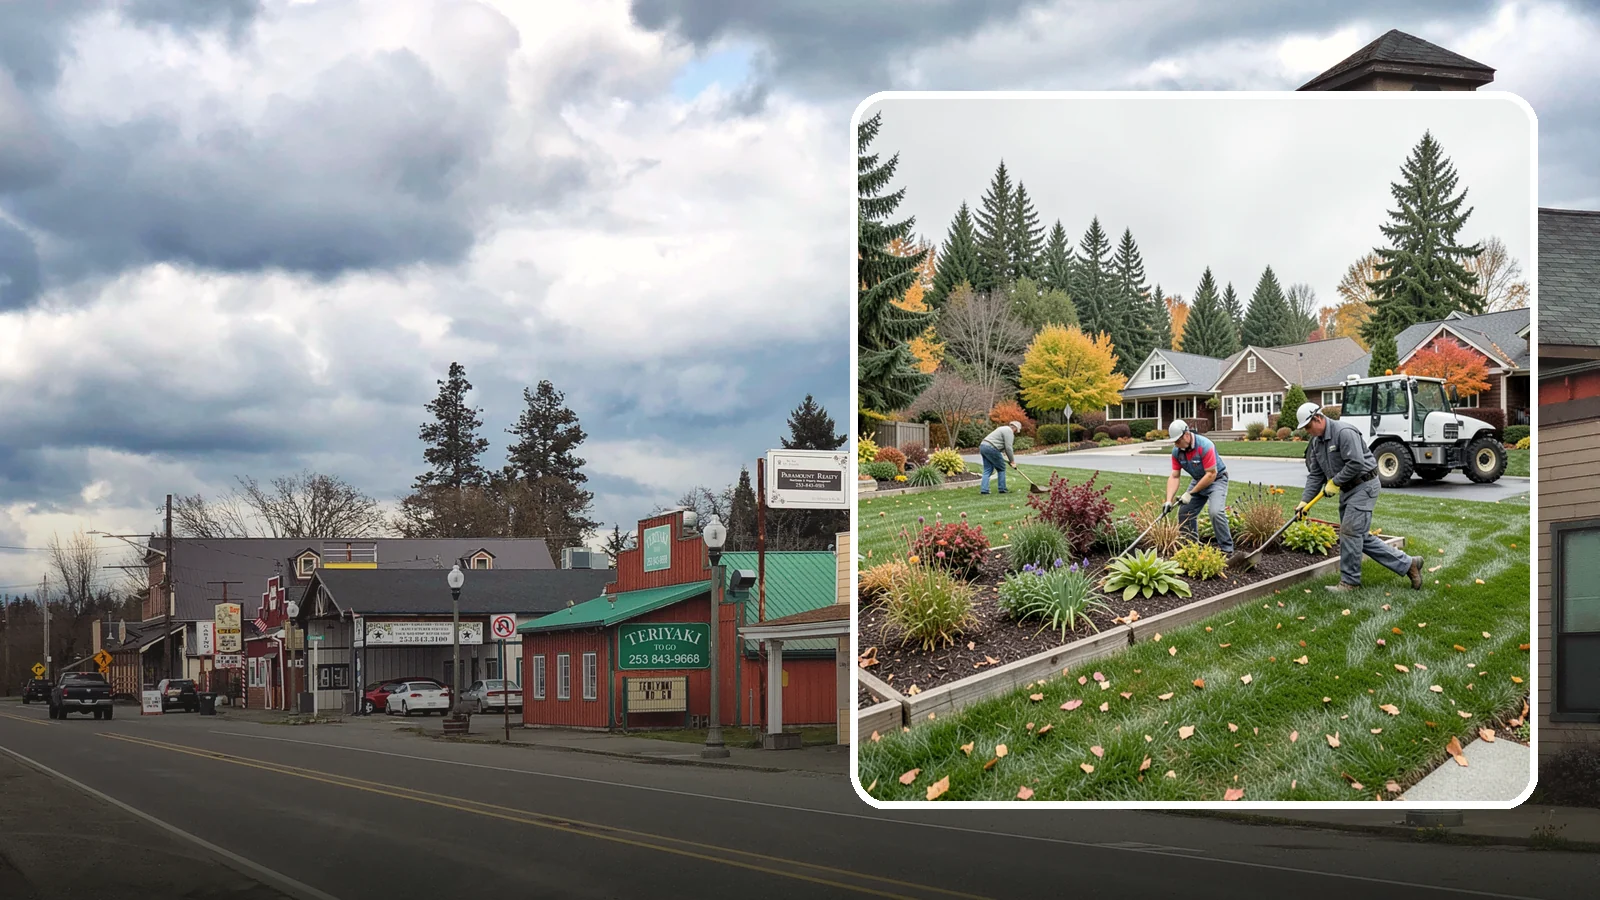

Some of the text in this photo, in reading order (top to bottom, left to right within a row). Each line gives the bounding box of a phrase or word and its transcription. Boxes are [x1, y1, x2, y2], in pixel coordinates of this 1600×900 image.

[781, 471, 815, 479] PARAMOUNT
[624, 627, 702, 646] TERIYAKI
[628, 654, 700, 665] 253 843-9668
